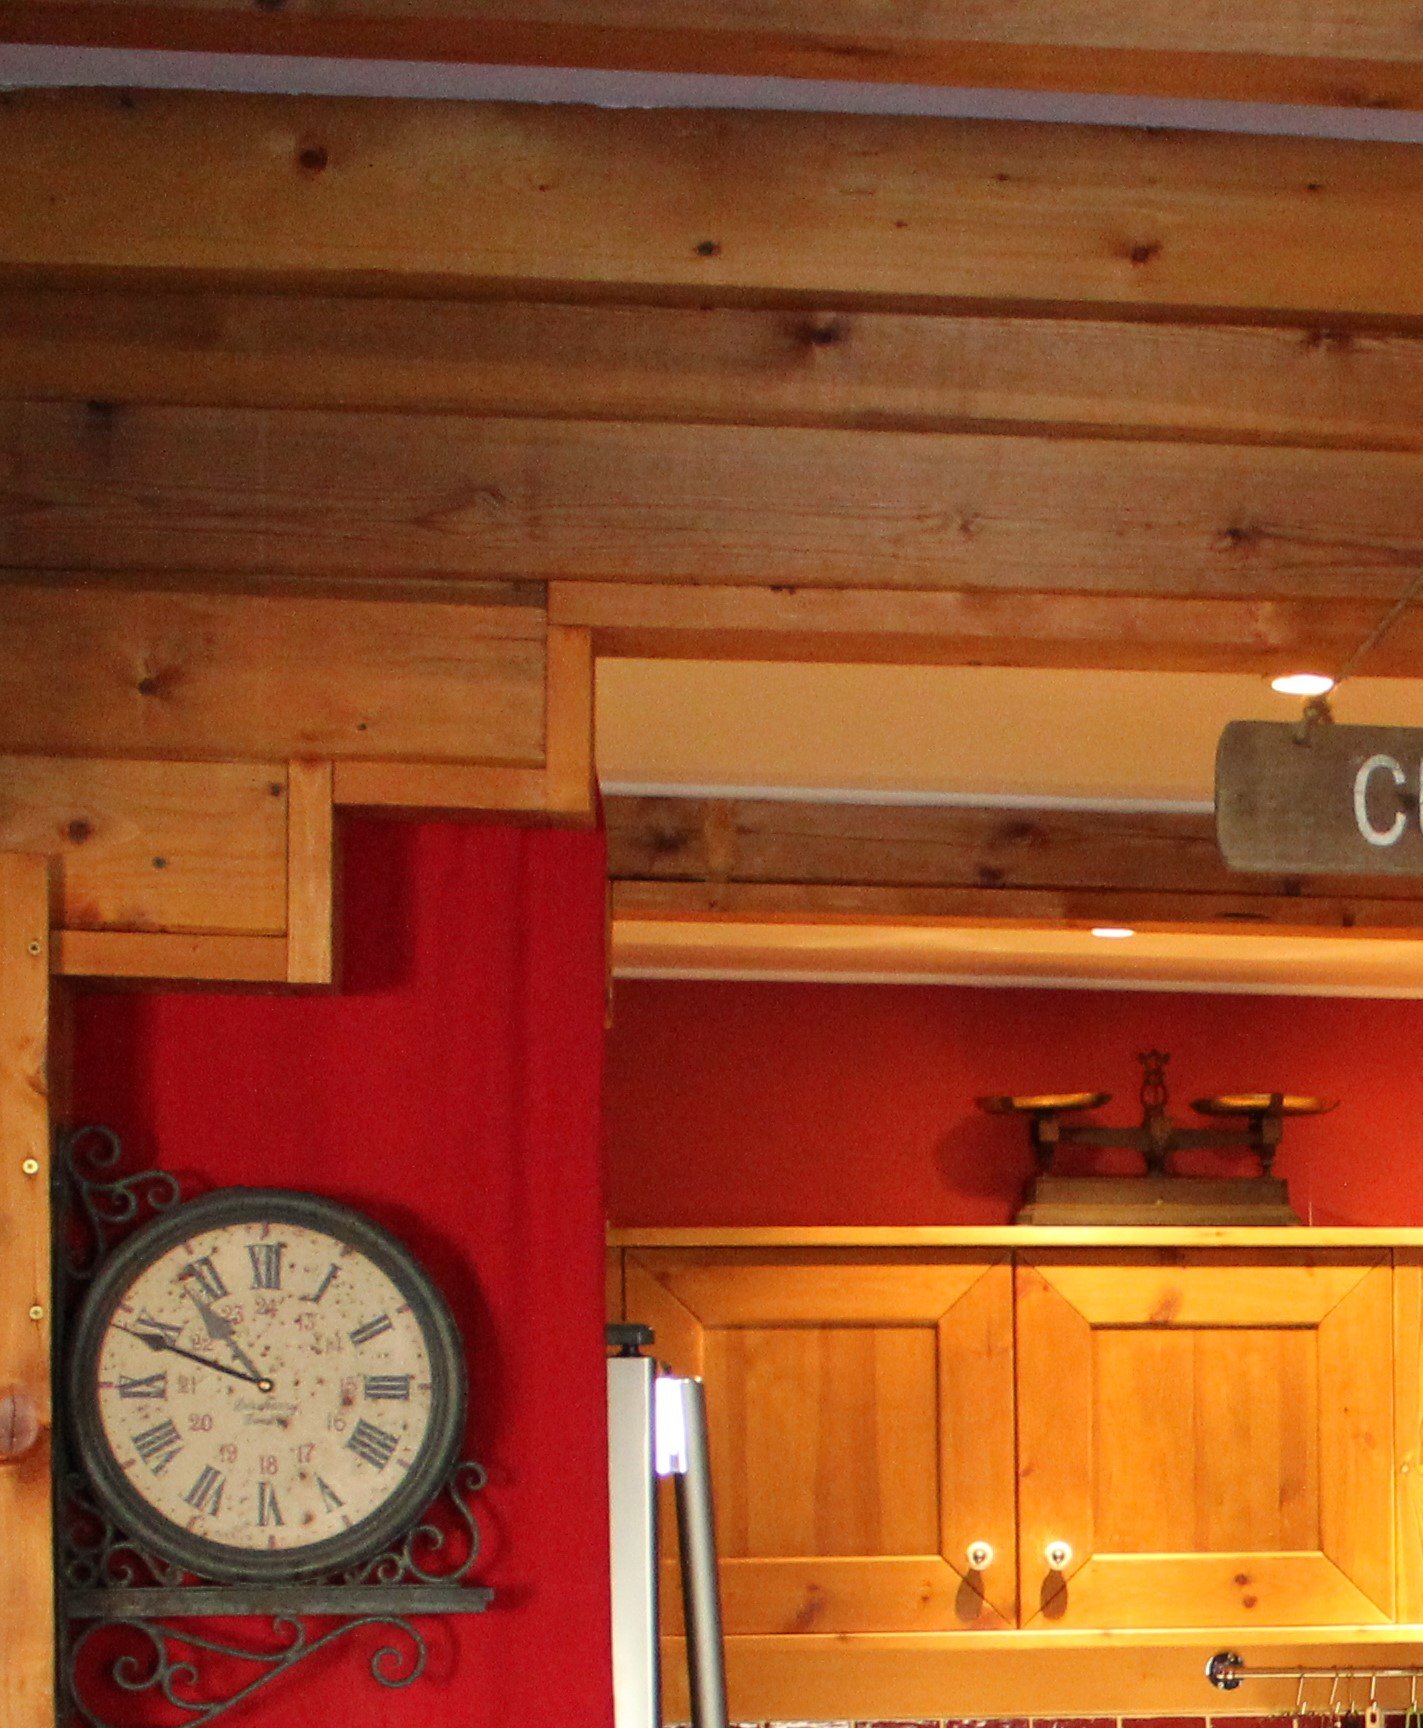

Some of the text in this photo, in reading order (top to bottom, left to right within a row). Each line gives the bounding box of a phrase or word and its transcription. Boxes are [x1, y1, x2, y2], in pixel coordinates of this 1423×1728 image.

[245, 1243, 282, 1290] XII
[348, 1313, 394, 1347] II
[364, 1374, 410, 1400] III
[188, 1413, 213, 1432] 20
[347, 1418, 399, 1470] IIII
[259, 1454, 280, 1475] 18
[184, 1464, 227, 1517] VII
[257, 1482, 284, 1526] VI
